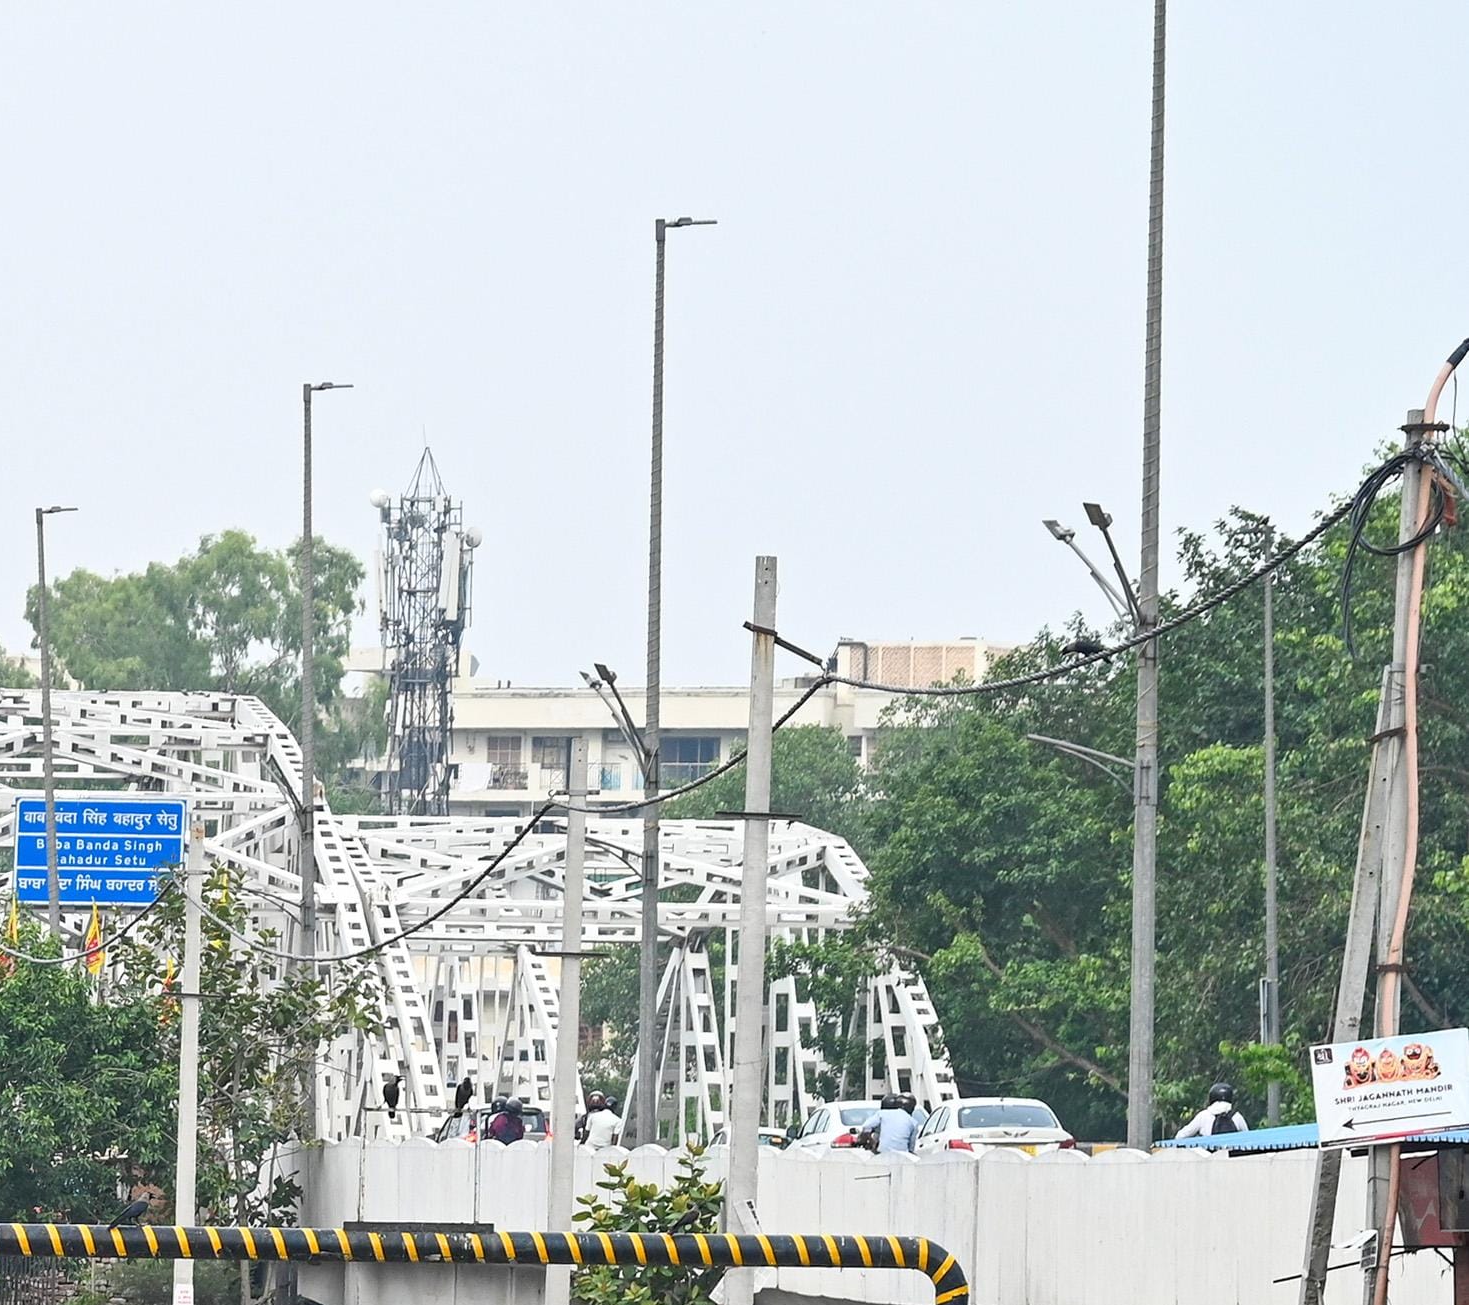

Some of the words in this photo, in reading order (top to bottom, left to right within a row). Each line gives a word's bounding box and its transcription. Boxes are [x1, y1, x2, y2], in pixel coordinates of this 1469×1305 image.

[82, 807, 108, 826] सिंह
[113, 810, 152, 831] बहादुर
[156, 809, 178, 831] सेतु
[36, 838, 71, 850] Bba
[76, 839, 119, 851] Banda
[124, 839, 163, 854] Singh
[55, 854, 108, 865] ahadur
[114, 855, 147, 866] Setu
[1334, 1095, 1356, 1106] SHRI
[1358, 1088, 1414, 1103] JAGANNATH
[1415, 1083, 1454, 1096] MANDIR
